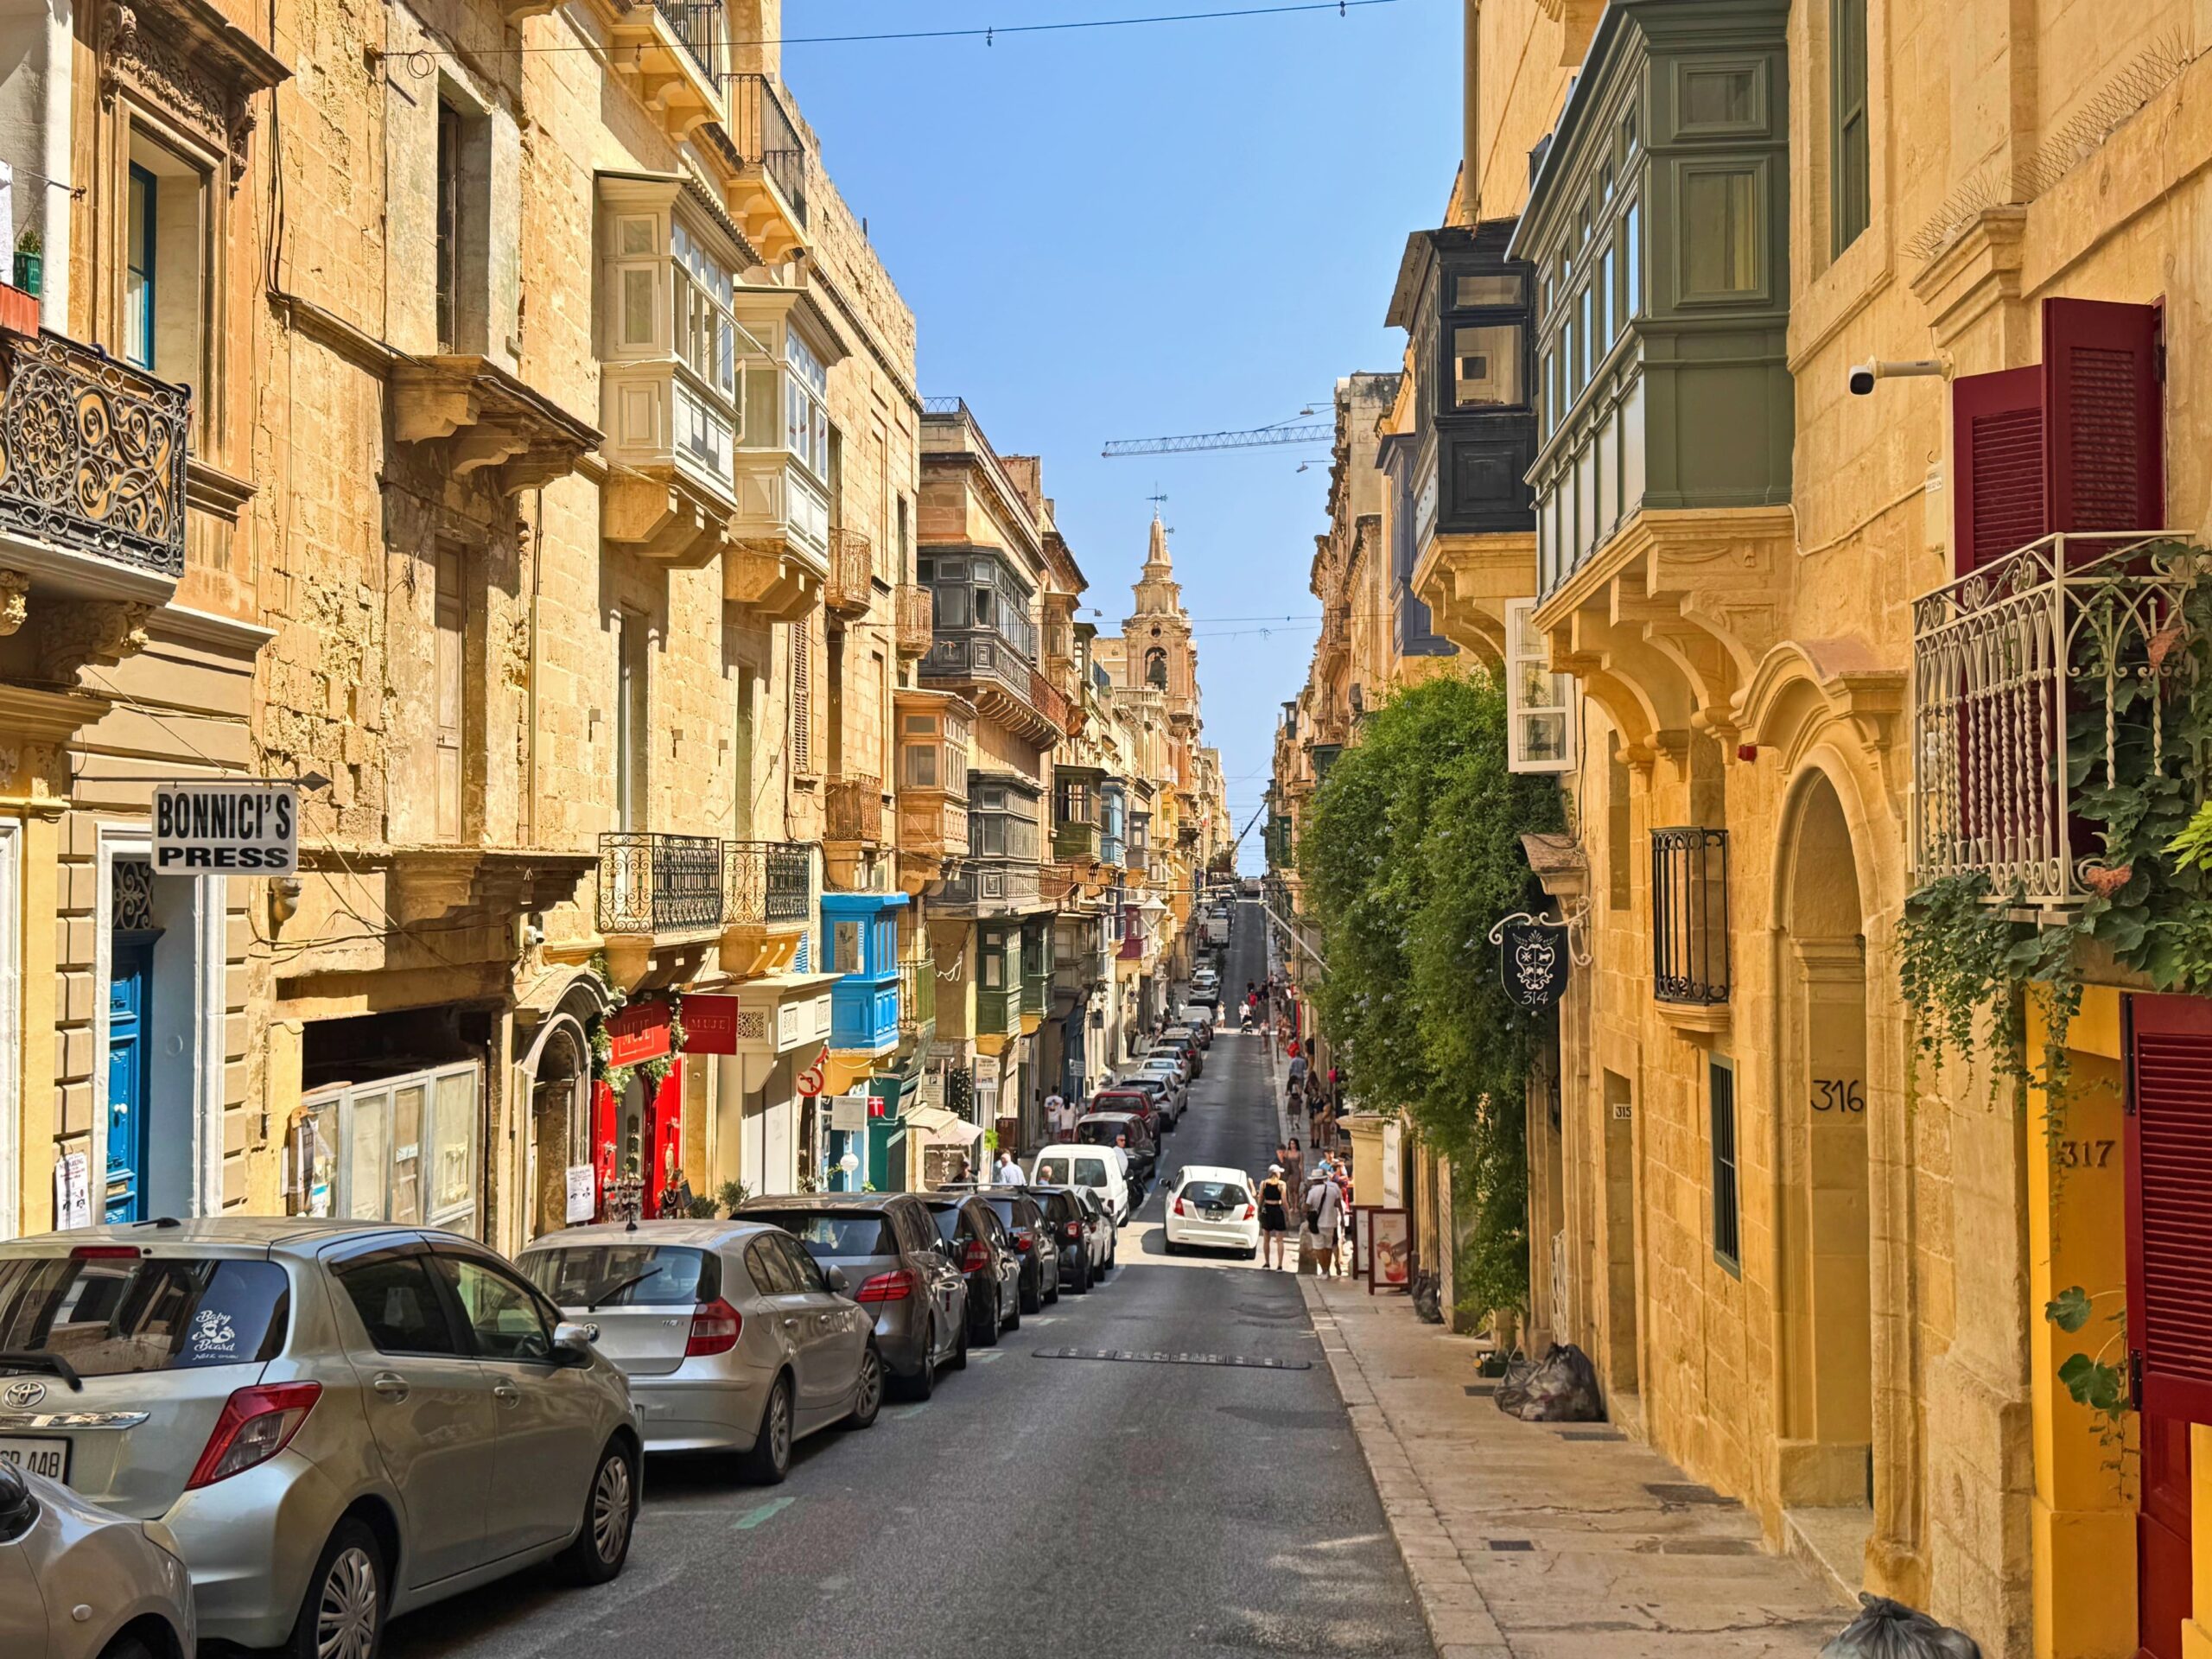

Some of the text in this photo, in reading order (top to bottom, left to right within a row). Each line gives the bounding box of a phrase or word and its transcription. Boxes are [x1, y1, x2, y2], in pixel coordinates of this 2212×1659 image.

[158, 793, 290, 840] BONNICI'S
[159, 847, 289, 868] PRESS
[1522, 991, 1548, 1005] 314
[622, 1019, 651, 1046] MUJE
[691, 1018, 725, 1030] MUJE
[1810, 1079, 1864, 1113] 316
[1616, 1106, 1631, 1118] 315
[2058, 1141, 2115, 1168] 317
[195, 1310, 232, 1325] Baby
[194, 1338, 235, 1351] Board
[27, 1452, 60, 1478] 448
